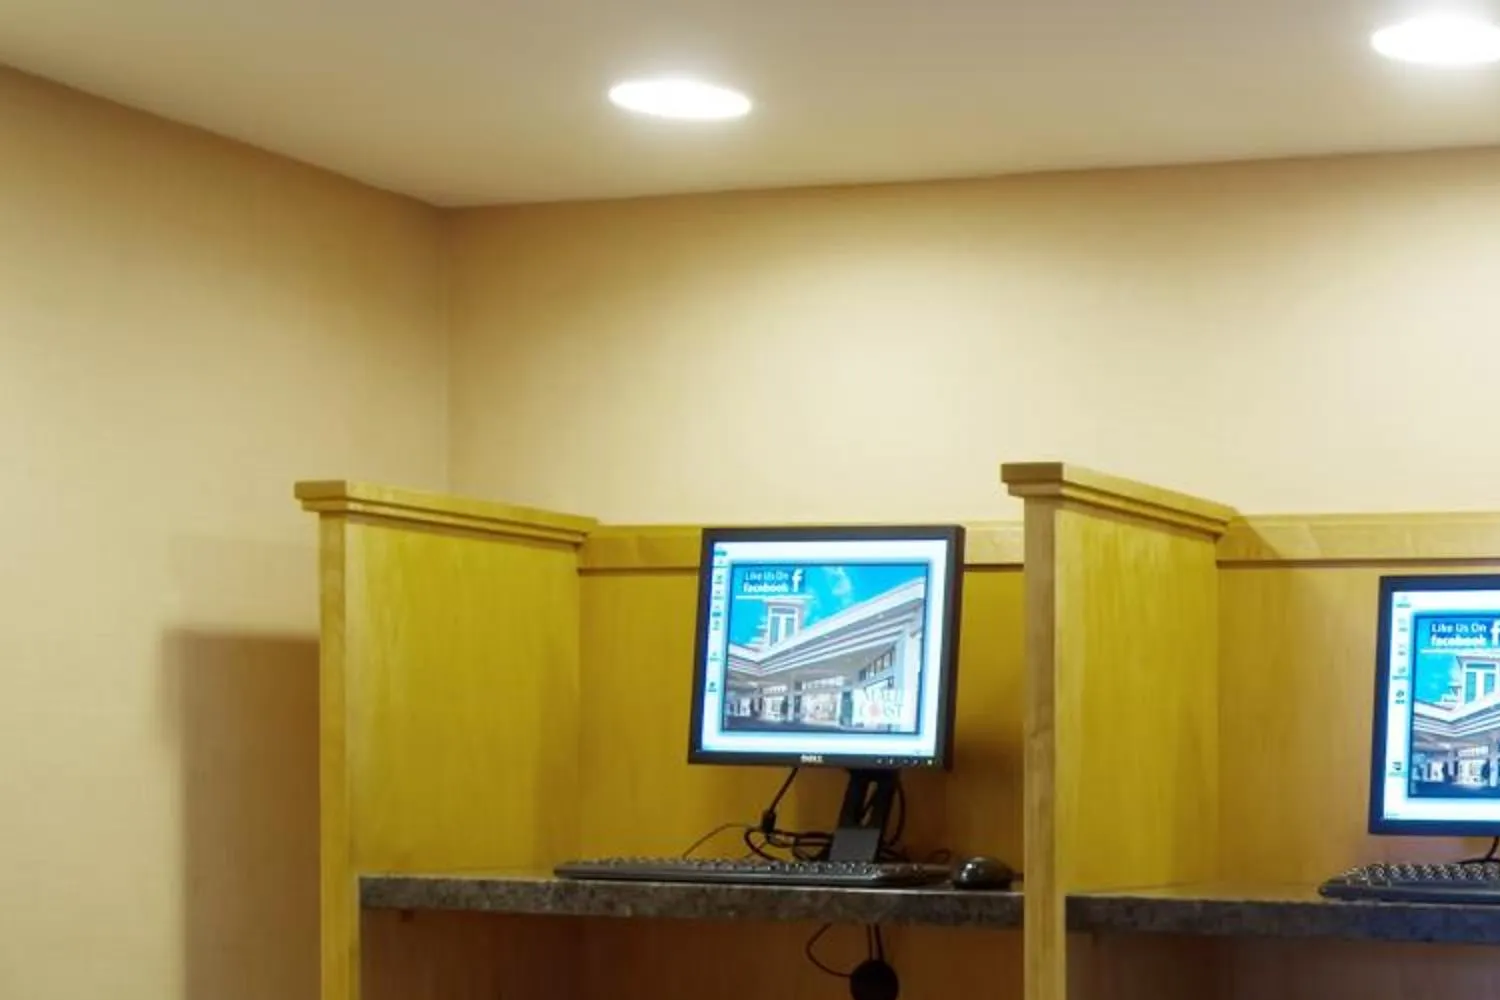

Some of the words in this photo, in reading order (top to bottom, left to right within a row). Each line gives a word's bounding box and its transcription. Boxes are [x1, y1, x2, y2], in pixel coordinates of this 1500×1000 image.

[1431, 623, 1454, 633] Like
[1455, 623, 1470, 633] Us
[1470, 622, 1488, 633] On
[800, 754, 824, 764] DELL
